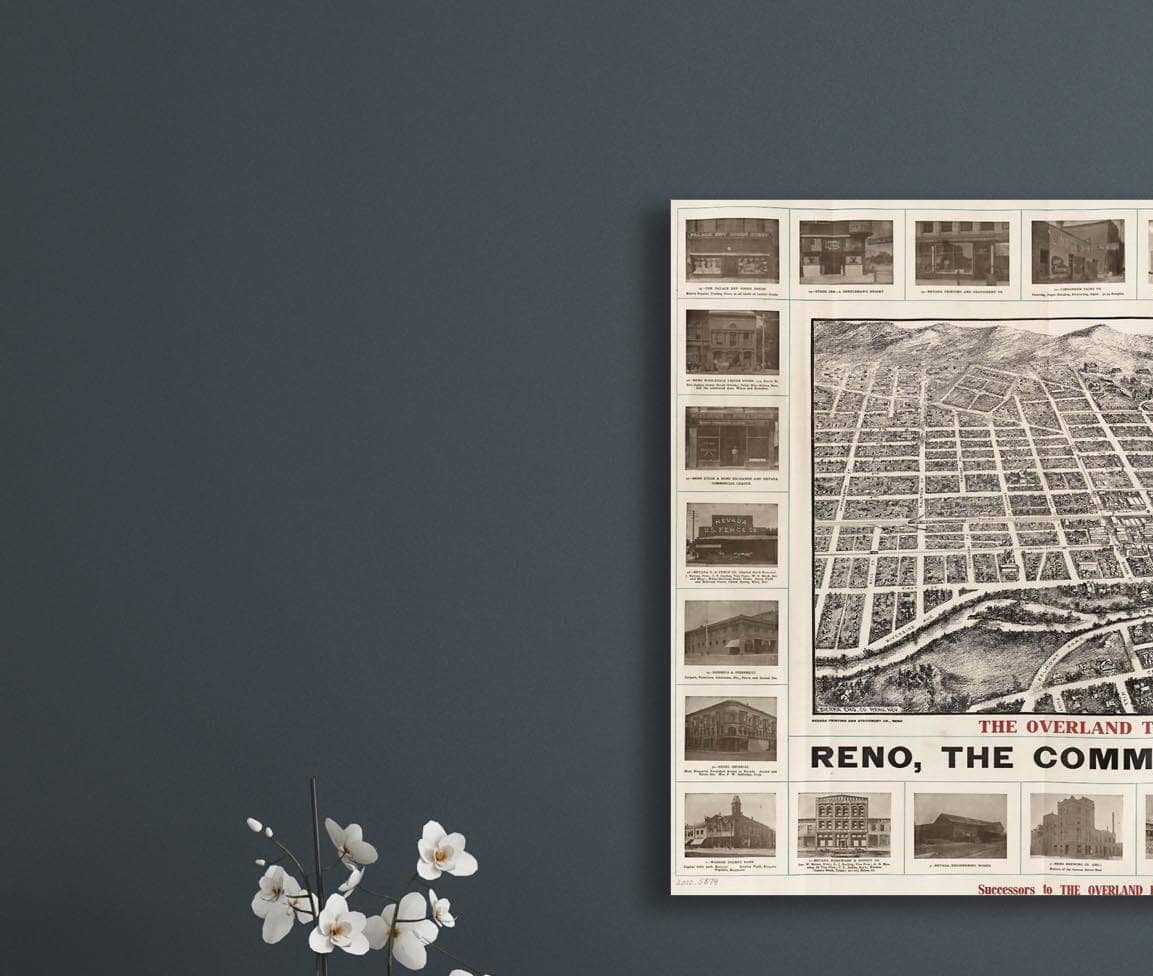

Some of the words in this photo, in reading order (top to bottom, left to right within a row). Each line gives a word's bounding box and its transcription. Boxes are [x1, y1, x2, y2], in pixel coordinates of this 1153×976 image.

[978, 720, 1017, 734] THE
[1026, 719, 1133, 735] OVERLAND
[811, 746, 922, 774] RENO,
[941, 746, 1014, 769] THE
[977, 883, 1036, 895] Successors
[1043, 883, 1053, 895] to
[1060, 884, 1081, 896] THE
[1087, 884, 1144, 896] OVERLAND
